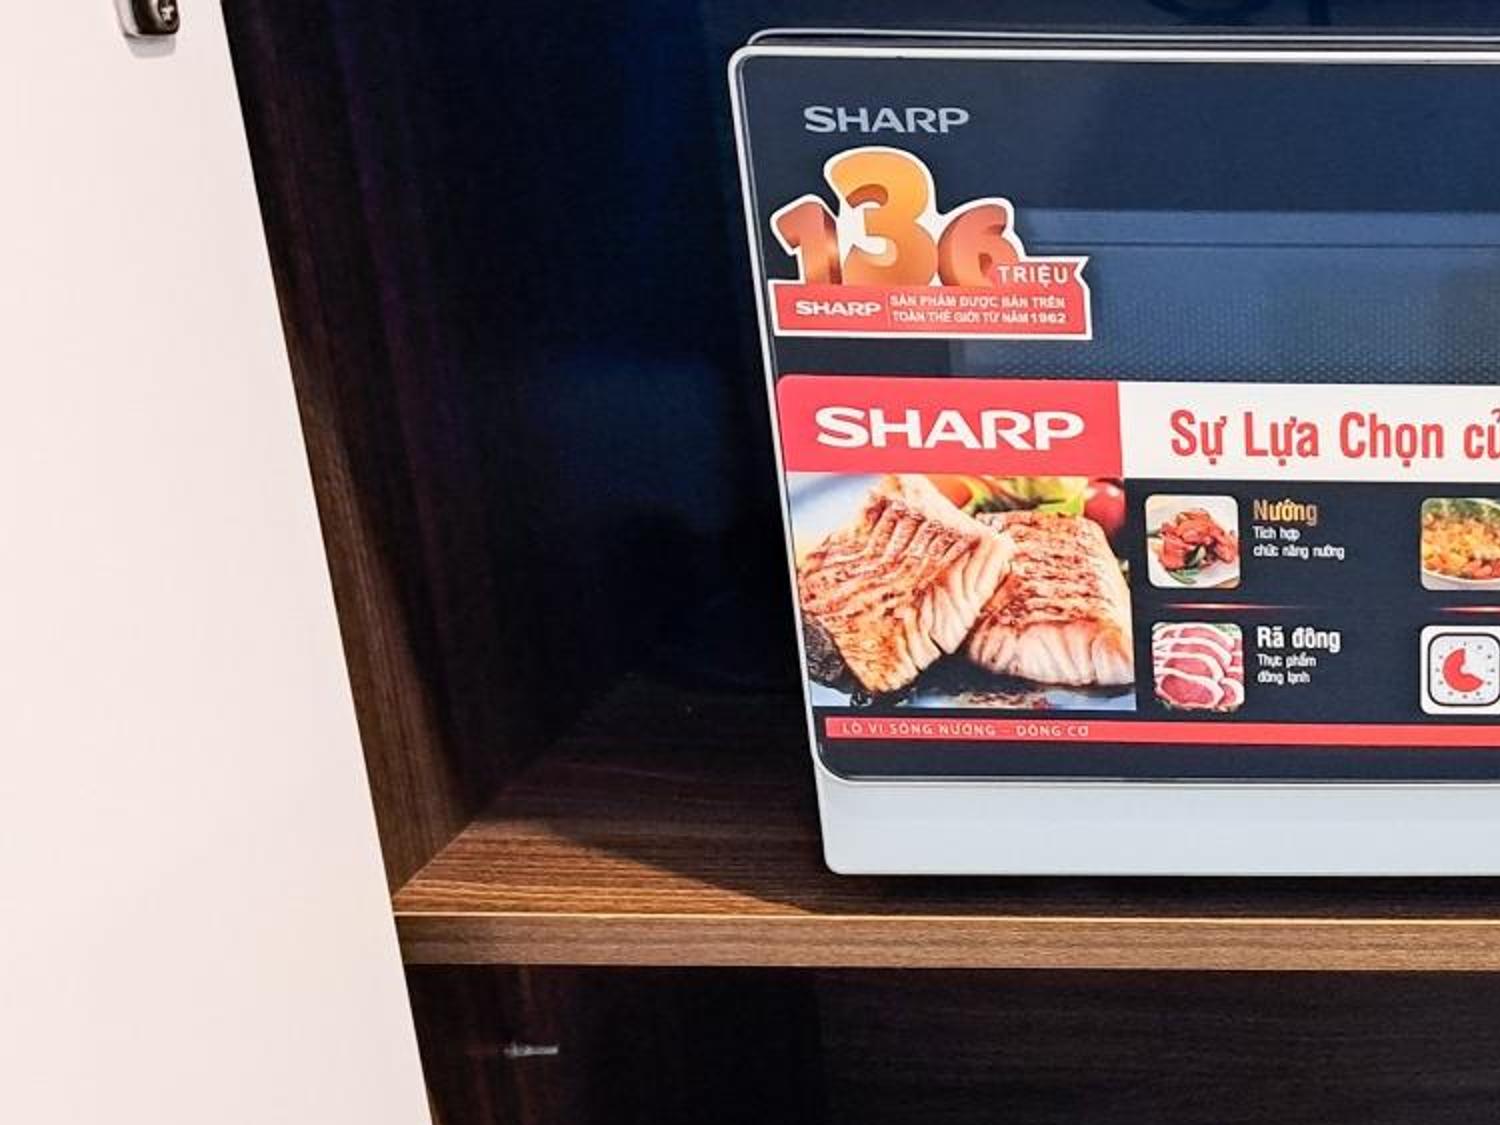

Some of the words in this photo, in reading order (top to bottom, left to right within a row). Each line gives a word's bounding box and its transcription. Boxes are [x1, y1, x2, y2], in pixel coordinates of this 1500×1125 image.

[804, 106, 969, 133] SHARP
[773, 150, 1021, 285] 136
[998, 265, 1068, 288] TRIỆU
[796, 301, 881, 316] SHARP
[815, 407, 1085, 450] SHARP
[1170, 409, 1227, 465] Sự
[1244, 411, 1319, 466] Lựa
[1340, 411, 1444, 468] Chọn
[1253, 498, 1317, 528] Nướng
[1257, 626, 1284, 648] Rã
[1292, 627, 1341, 653] đông
[868, 722, 884, 734] VI
